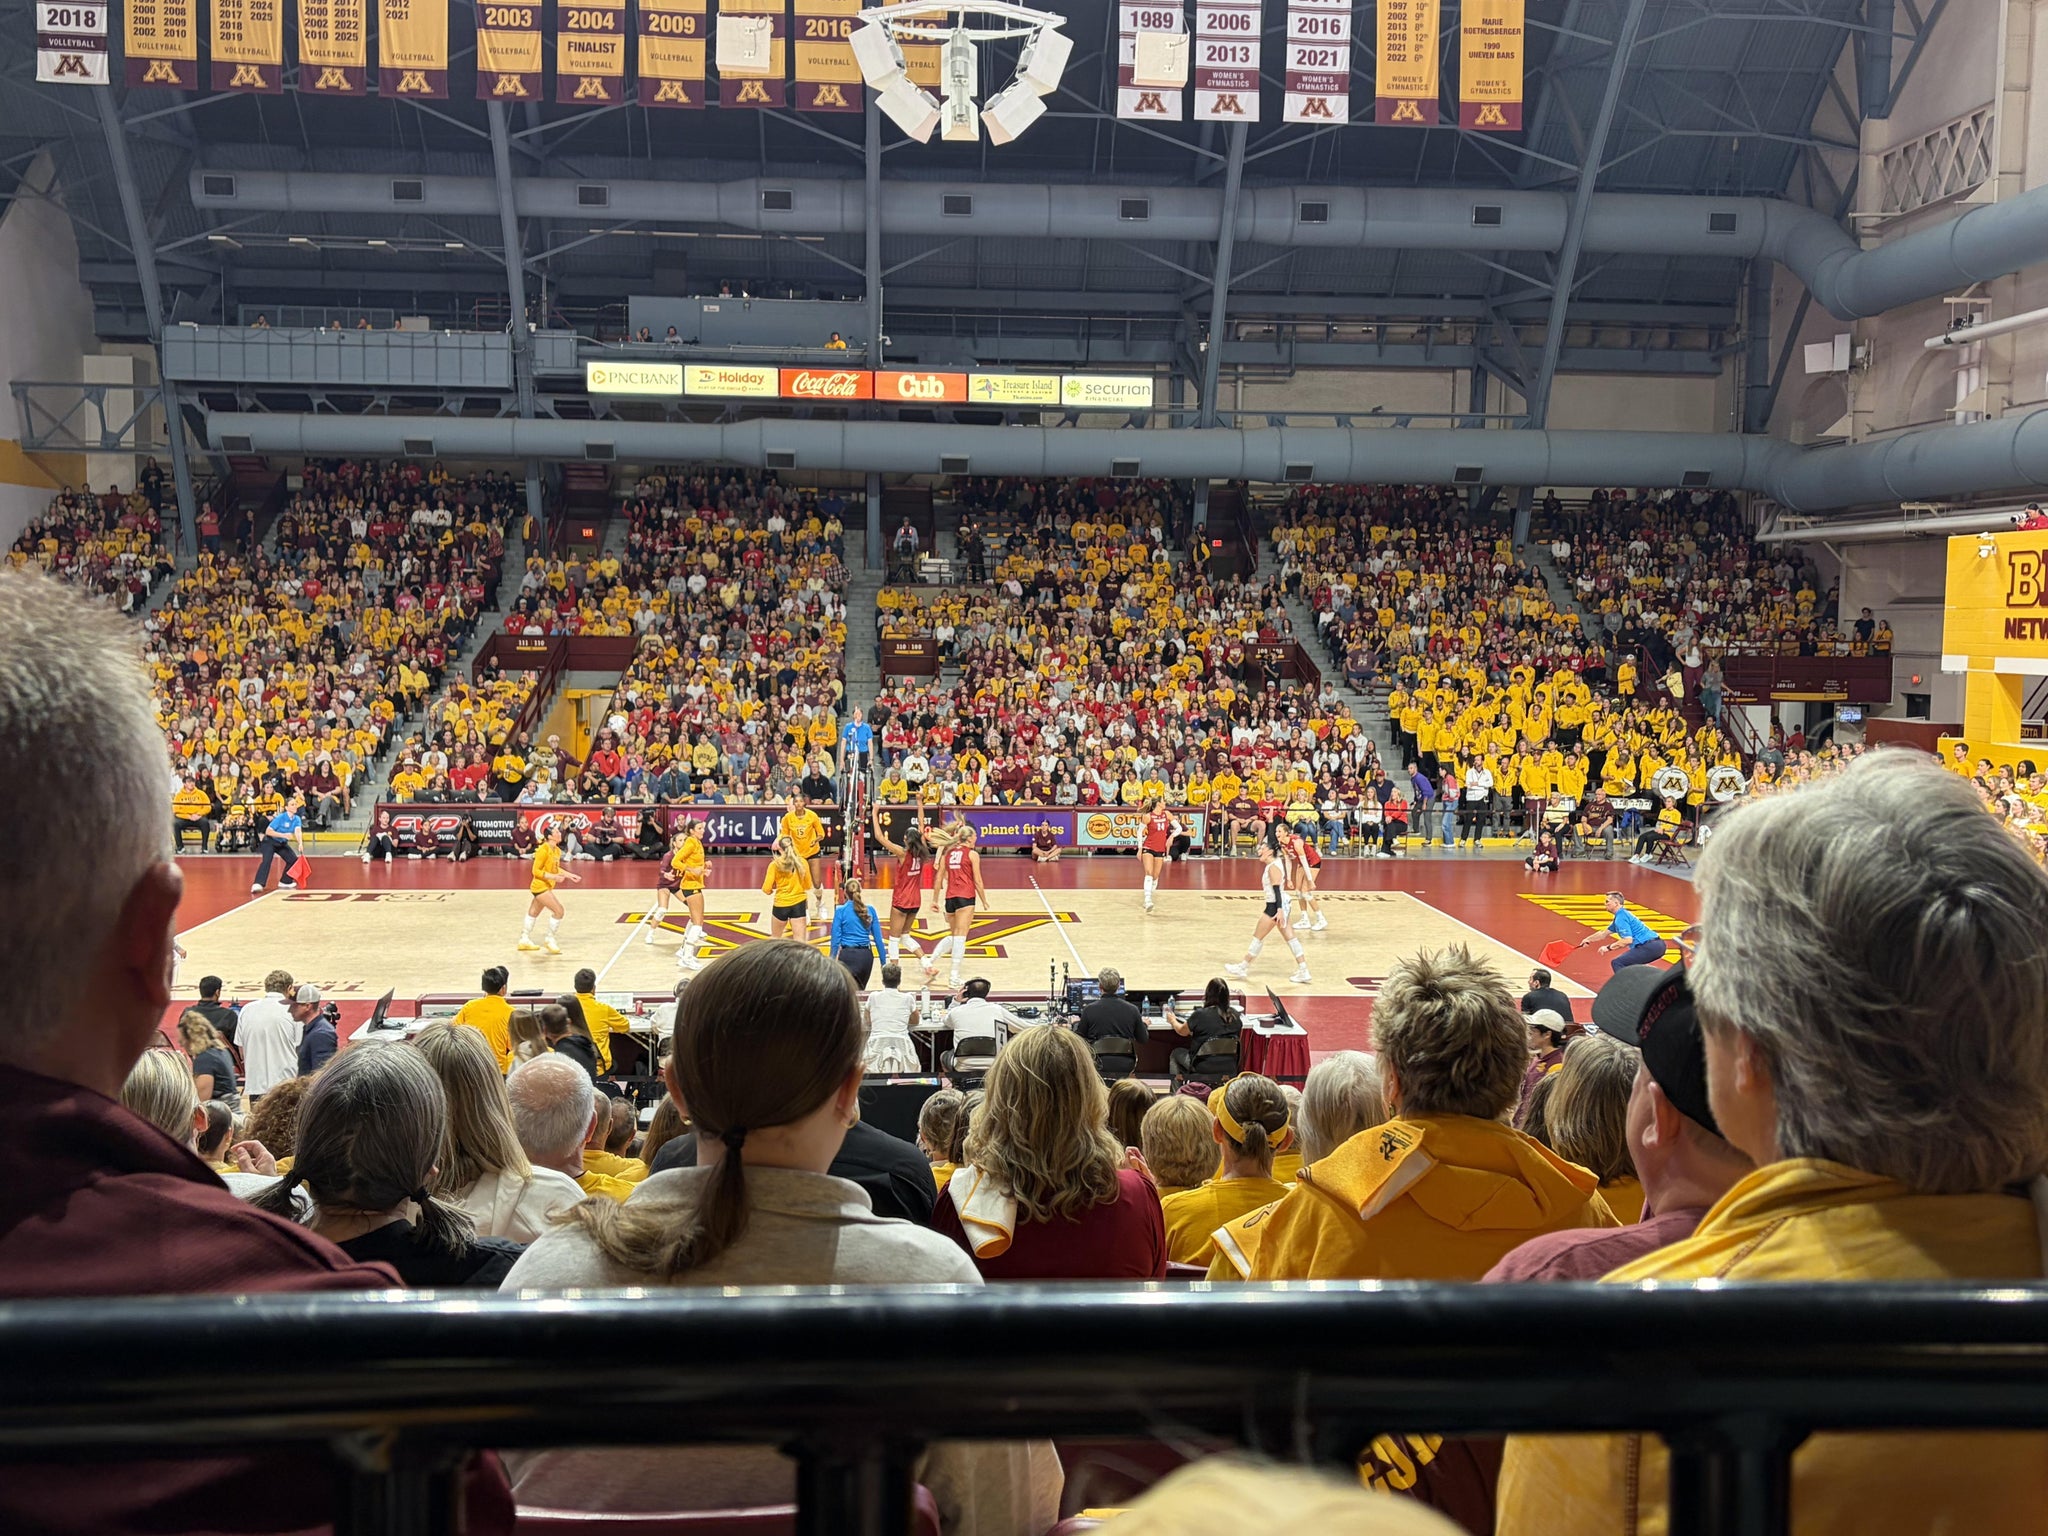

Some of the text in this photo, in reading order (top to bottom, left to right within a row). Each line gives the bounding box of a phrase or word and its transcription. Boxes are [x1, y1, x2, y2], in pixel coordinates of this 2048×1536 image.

[133, 5, 186, 16] 2000 2008
[250, 1, 273, 11] 2024
[1388, 2, 1407, 10] 1997
[47, 8, 97, 28] 2018
[219, 10, 273, 22] 2017 2025
[304, 7, 358, 18] 2000 2018
[385, 10, 409, 20] 2021
[485, 8, 533, 27] 2003
[1387, 12, 1407, 20] 2002
[133, 16, 186, 27] 2001 2009
[304, 18, 358, 30] 2002 2022
[567, 10, 615, 30] 2004
[648, 14, 696, 34] 2009
[1130, 11, 1173, 28] 1989
[1207, 13, 1250, 31] 2006
[1482, 18, 1503, 26] MARIE
[219, 21, 242, 31] 2018
[805, 19, 852, 38] 2016
[1298, 17, 1341, 35] 2016
[1387, 23, 1407, 31] 2013
[1463, 27, 1521, 35] ROETHLISBERGER
[133, 27, 187, 39] 2002 2010
[219, 32, 243, 41] 2019
[304, 30, 358, 42] 2010 2025
[1387, 33, 1407, 41] 2016
[48, 38, 96, 48] VOLLEYBALL
[137, 42, 183, 51] VOLLEYBALL
[567, 41, 616, 54] FINALIST
[1387, 43, 1406, 52] 2021
[224, 46, 269, 56] VOLLEYBALL
[309, 49, 355, 59] VOLLEYBALL
[391, 52, 435, 62] VOLLEYBALL
[488, 47, 530, 56] VOLLEYBALL
[1206, 45, 1250, 63] 2013
[1469, 51, 1494, 59] UNEVEN
[650, 53, 693, 62] VOLLEYBALL
[808, 58, 850, 66] VOLLEYBALL
[1297, 49, 1338, 66] 2021
[1387, 53, 1407, 62] 2022
[54, 54, 92, 78] M
[569, 60, 613, 69] VOLLEYBALL
[143, 60, 182, 84] M
[230, 64, 268, 88] M
[1212, 72, 1244, 80] WOMEN'S
[315, 67, 353, 91] M
[397, 70, 434, 93] M
[493, 74, 529, 96] M
[1207, 79, 1249, 87] GYMNASTICS
[1302, 75, 1333, 83] WOMEN'S
[1392, 75, 1423, 83] WOMEN'S
[573, 77, 611, 99] M
[654, 80, 692, 103] M
[736, 81, 773, 102] M
[1297, 83, 1339, 91] GYMNASTICS
[1387, 83, 1429, 91] GYMNASTICS
[812, 85, 850, 107] M
[1134, 92, 1168, 113] M
[1211, 94, 1245, 114] M
[1300, 97, 1334, 117] M
[1391, 100, 1425, 121] M
[1475, 104, 1508, 125] M
[719, 372, 764, 384] Holiday
[898, 374, 944, 398] Cub
[1002, 380, 1052, 389] Treasure Island
[1085, 383, 1150, 395] securian
[911, 817, 932, 825] GUST
[981, 824, 1020, 837] planet
